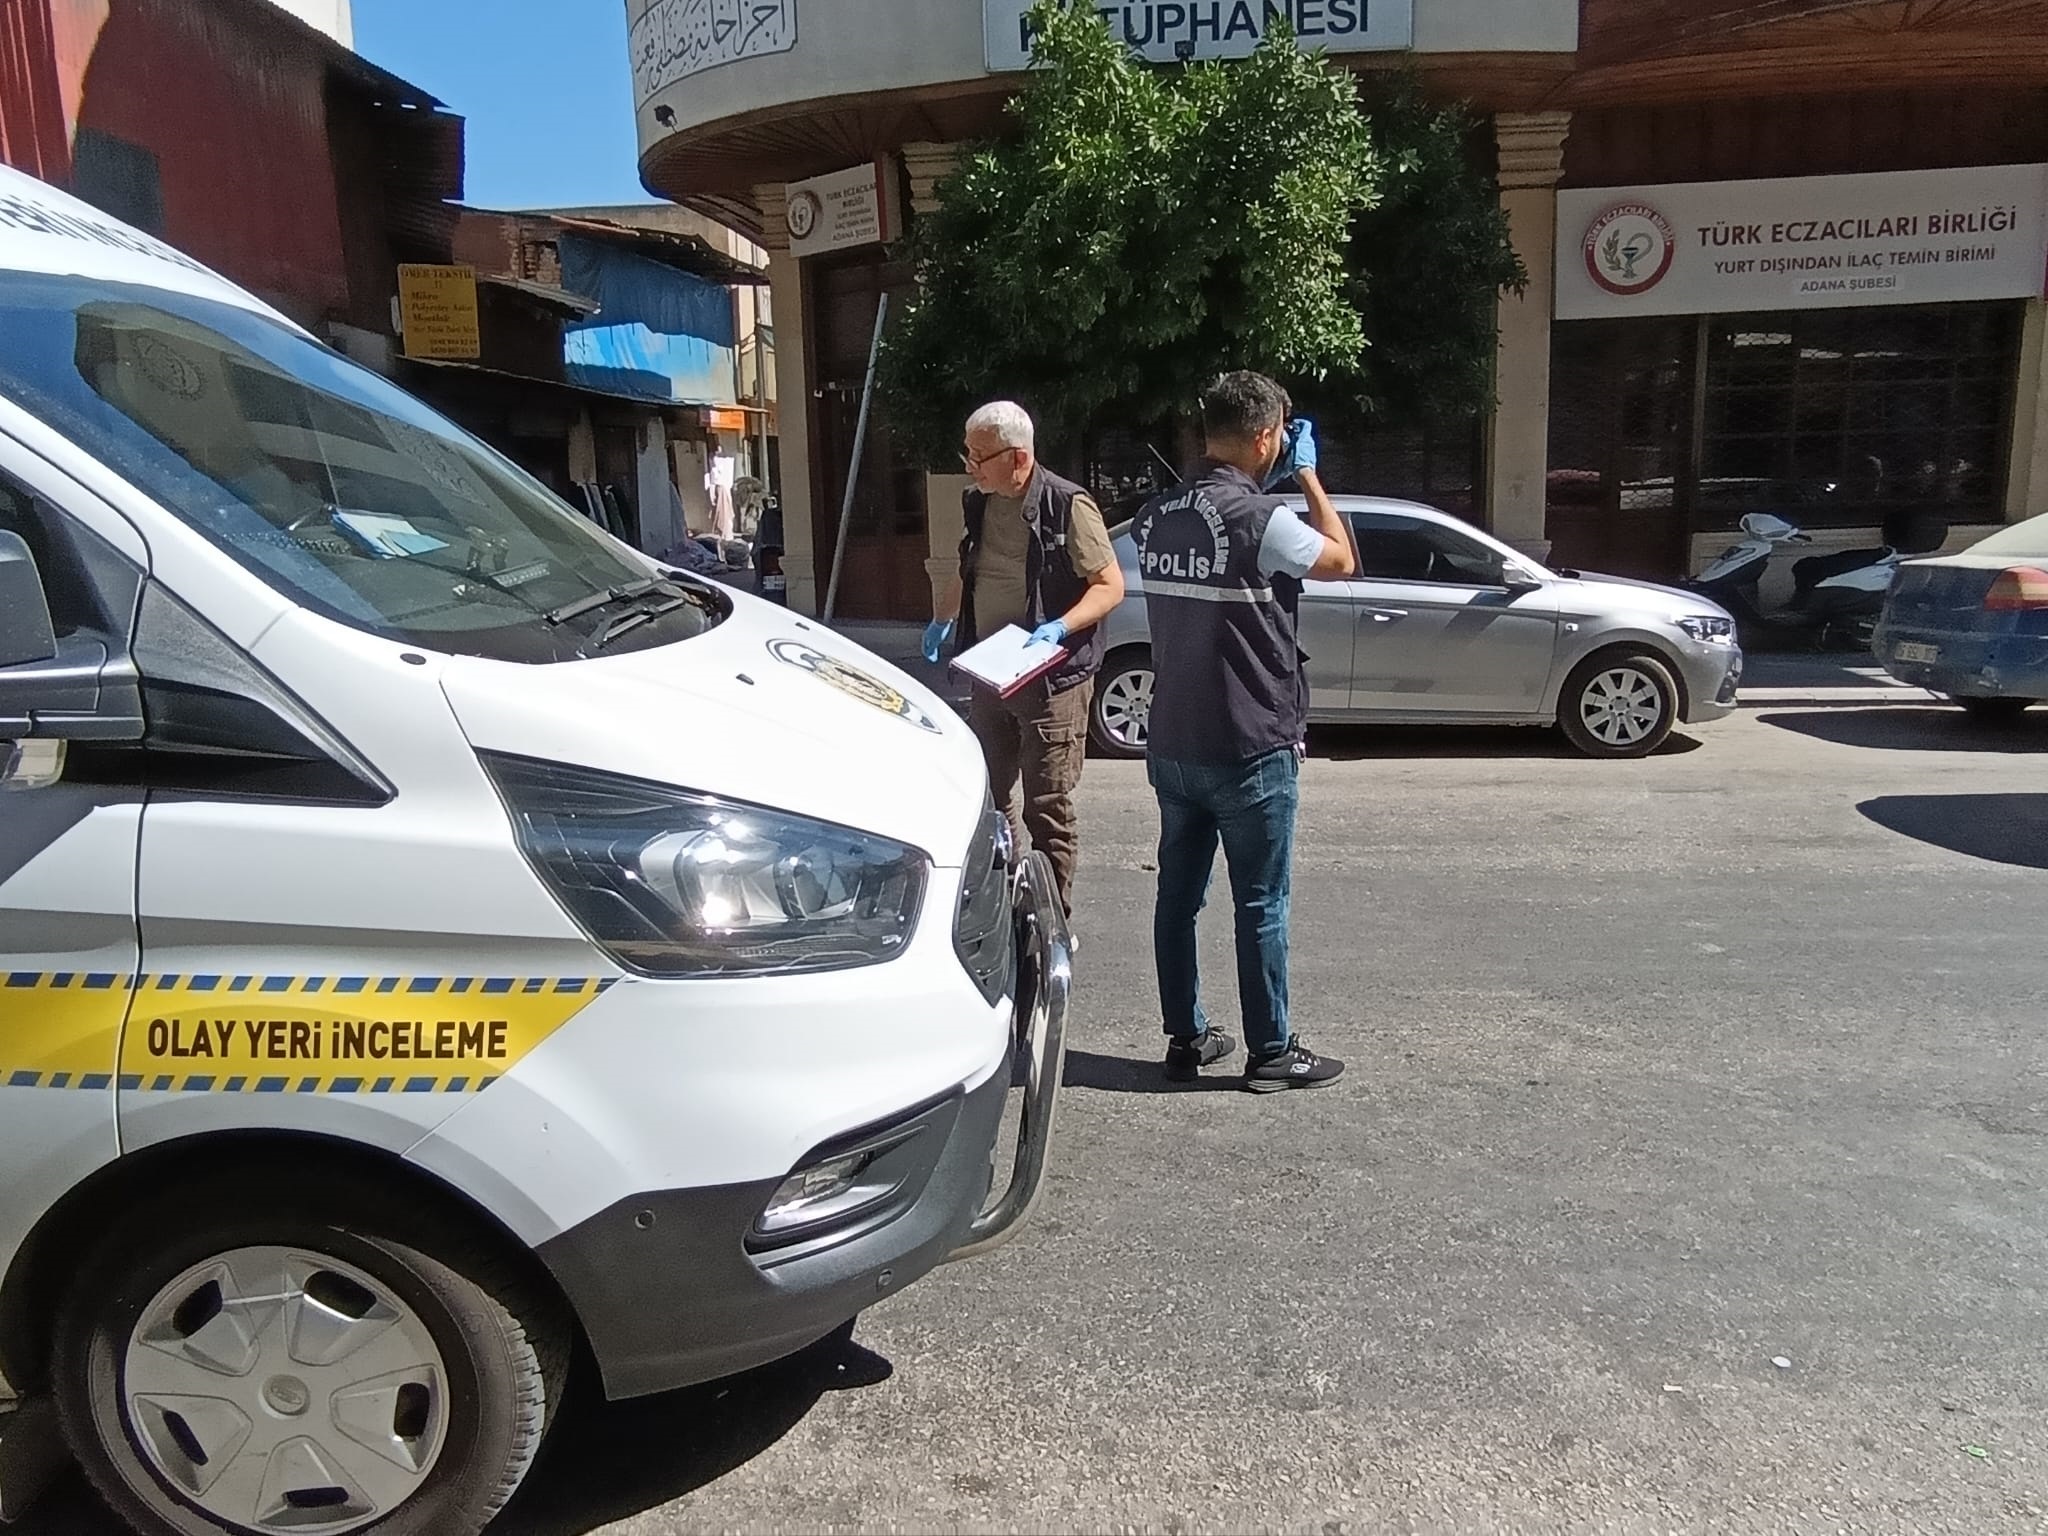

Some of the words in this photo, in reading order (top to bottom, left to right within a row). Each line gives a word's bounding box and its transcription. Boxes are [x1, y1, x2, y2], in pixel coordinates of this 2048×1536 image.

[1698, 221, 1762, 247] TÜRK
[1771, 215, 1918, 243] ECZACILARI
[1927, 205, 2016, 235] BİRLİĞİ
[1714, 259, 1755, 275] YURT
[1760, 255, 1842, 275] DIŞINDAN
[1847, 251, 1884, 270] İLAÇ
[1889, 248, 1940, 266] TEMİN
[1945, 244, 1995, 263] BİRİMİ
[1800, 279, 1846, 293] ADANA
[1849, 275, 1897, 291] ŞUBESİ
[1146, 547, 1210, 580] POLİS
[148, 1018, 237, 1058] OLAY
